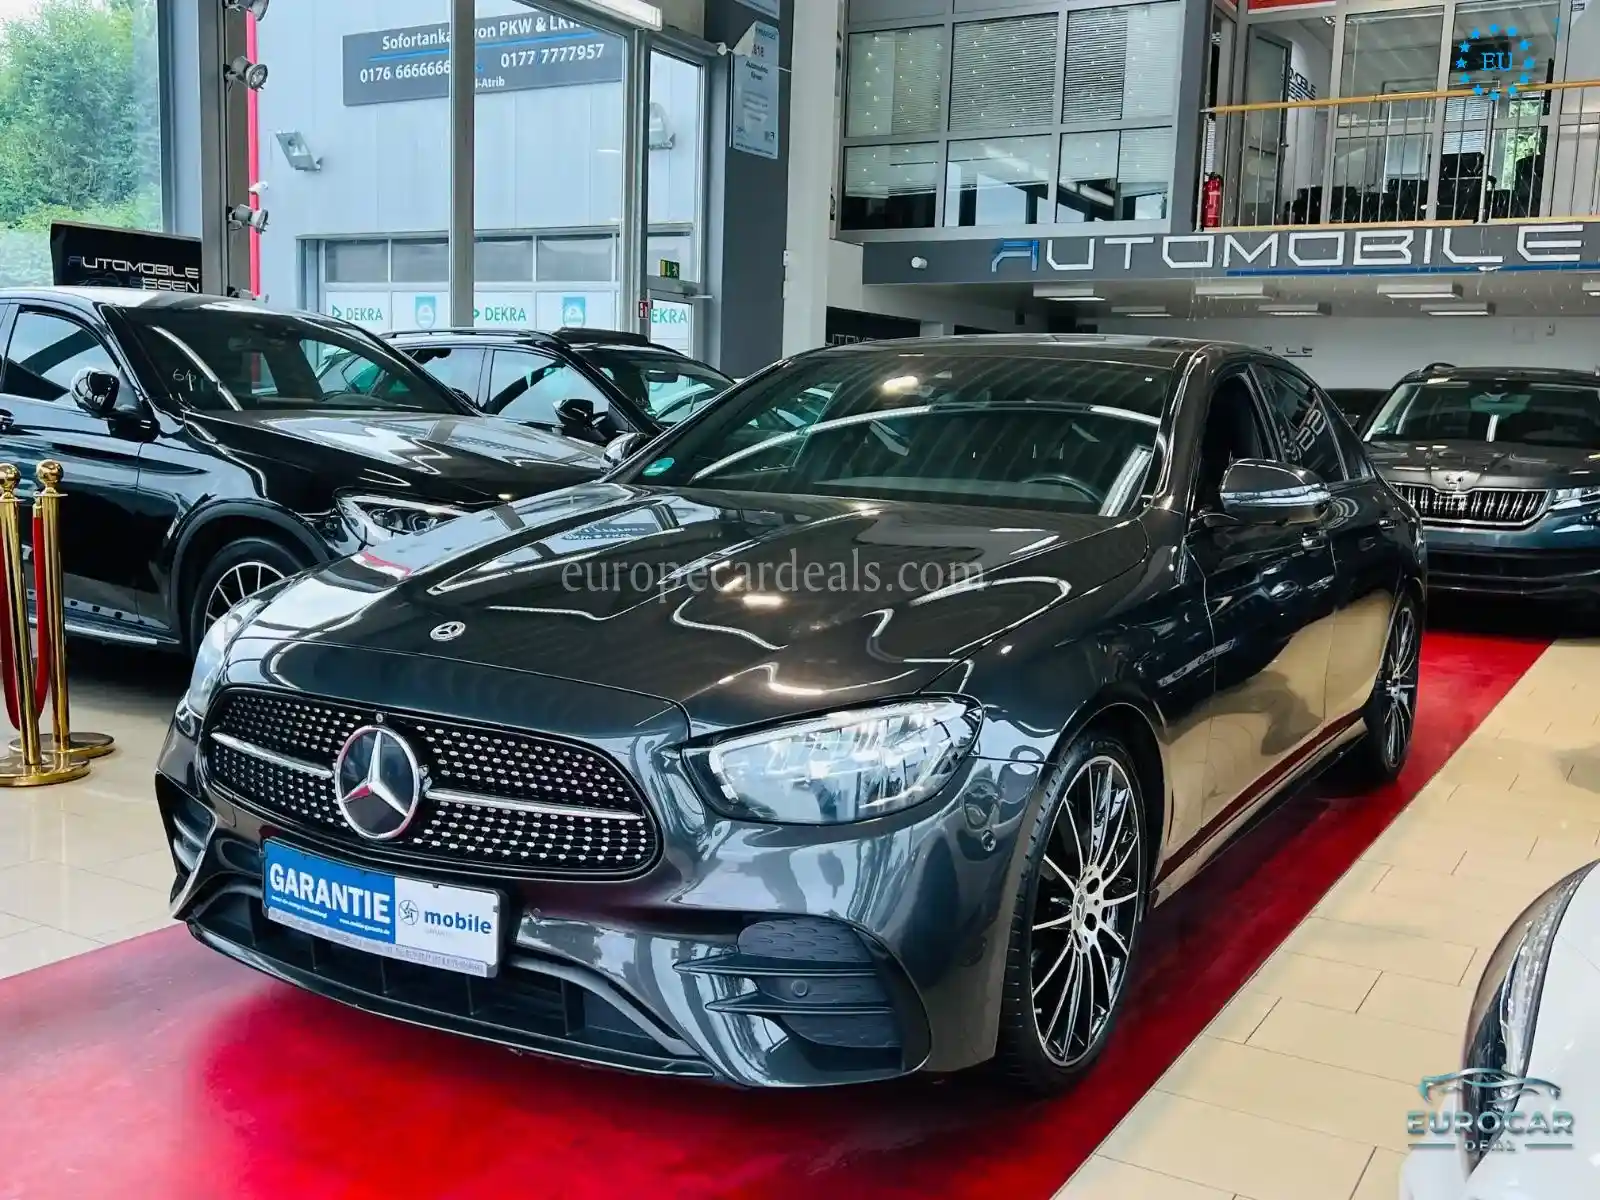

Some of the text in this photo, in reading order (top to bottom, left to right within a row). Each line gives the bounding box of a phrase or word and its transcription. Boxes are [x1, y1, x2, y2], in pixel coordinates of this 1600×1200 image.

[382, 28, 450, 50] Sofortanka
[500, 18, 532, 36] PKW
[535, 17, 546, 32] &
[360, 66, 391, 83] 0176
[500, 50, 535, 68] 0177
[541, 43, 605, 64] 7777957
[992, 224, 1585, 272] AUTOMOBILE
[67, 255, 199, 279] AUTOMOBILE
[129, 275, 200, 293] ESSEN
[346, 307, 688, 323] DEKRA DEKRA EKRA
[269, 862, 391, 924] GARANTIE
[424, 910, 492, 934] mobile
